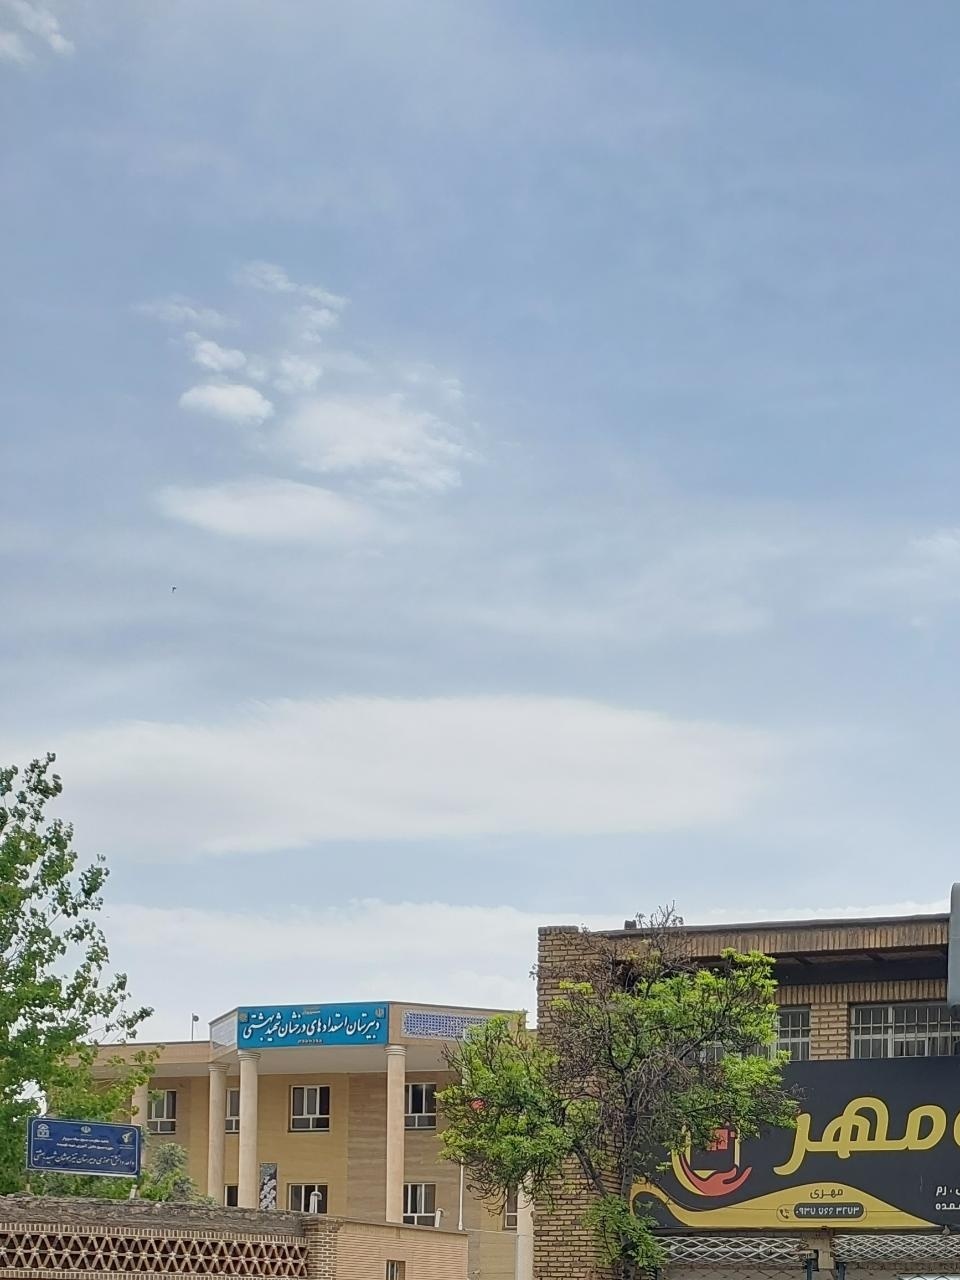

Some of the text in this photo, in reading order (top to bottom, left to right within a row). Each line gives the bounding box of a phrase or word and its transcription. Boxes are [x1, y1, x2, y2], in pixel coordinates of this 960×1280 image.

[243, 1012, 275, 1041] بهشتی
[265, 1012, 282, 1042] شهید
[278, 1011, 306, 1037] درخشان
[345, 1012, 380, 1039] دبیرستان
[774, 1096, 948, 1176] مهر
[809, 1188, 844, 1200] مهری
[935, 1185, 947, 1196] رم
[818, 1206, 834, 1216] ۷۶۶
